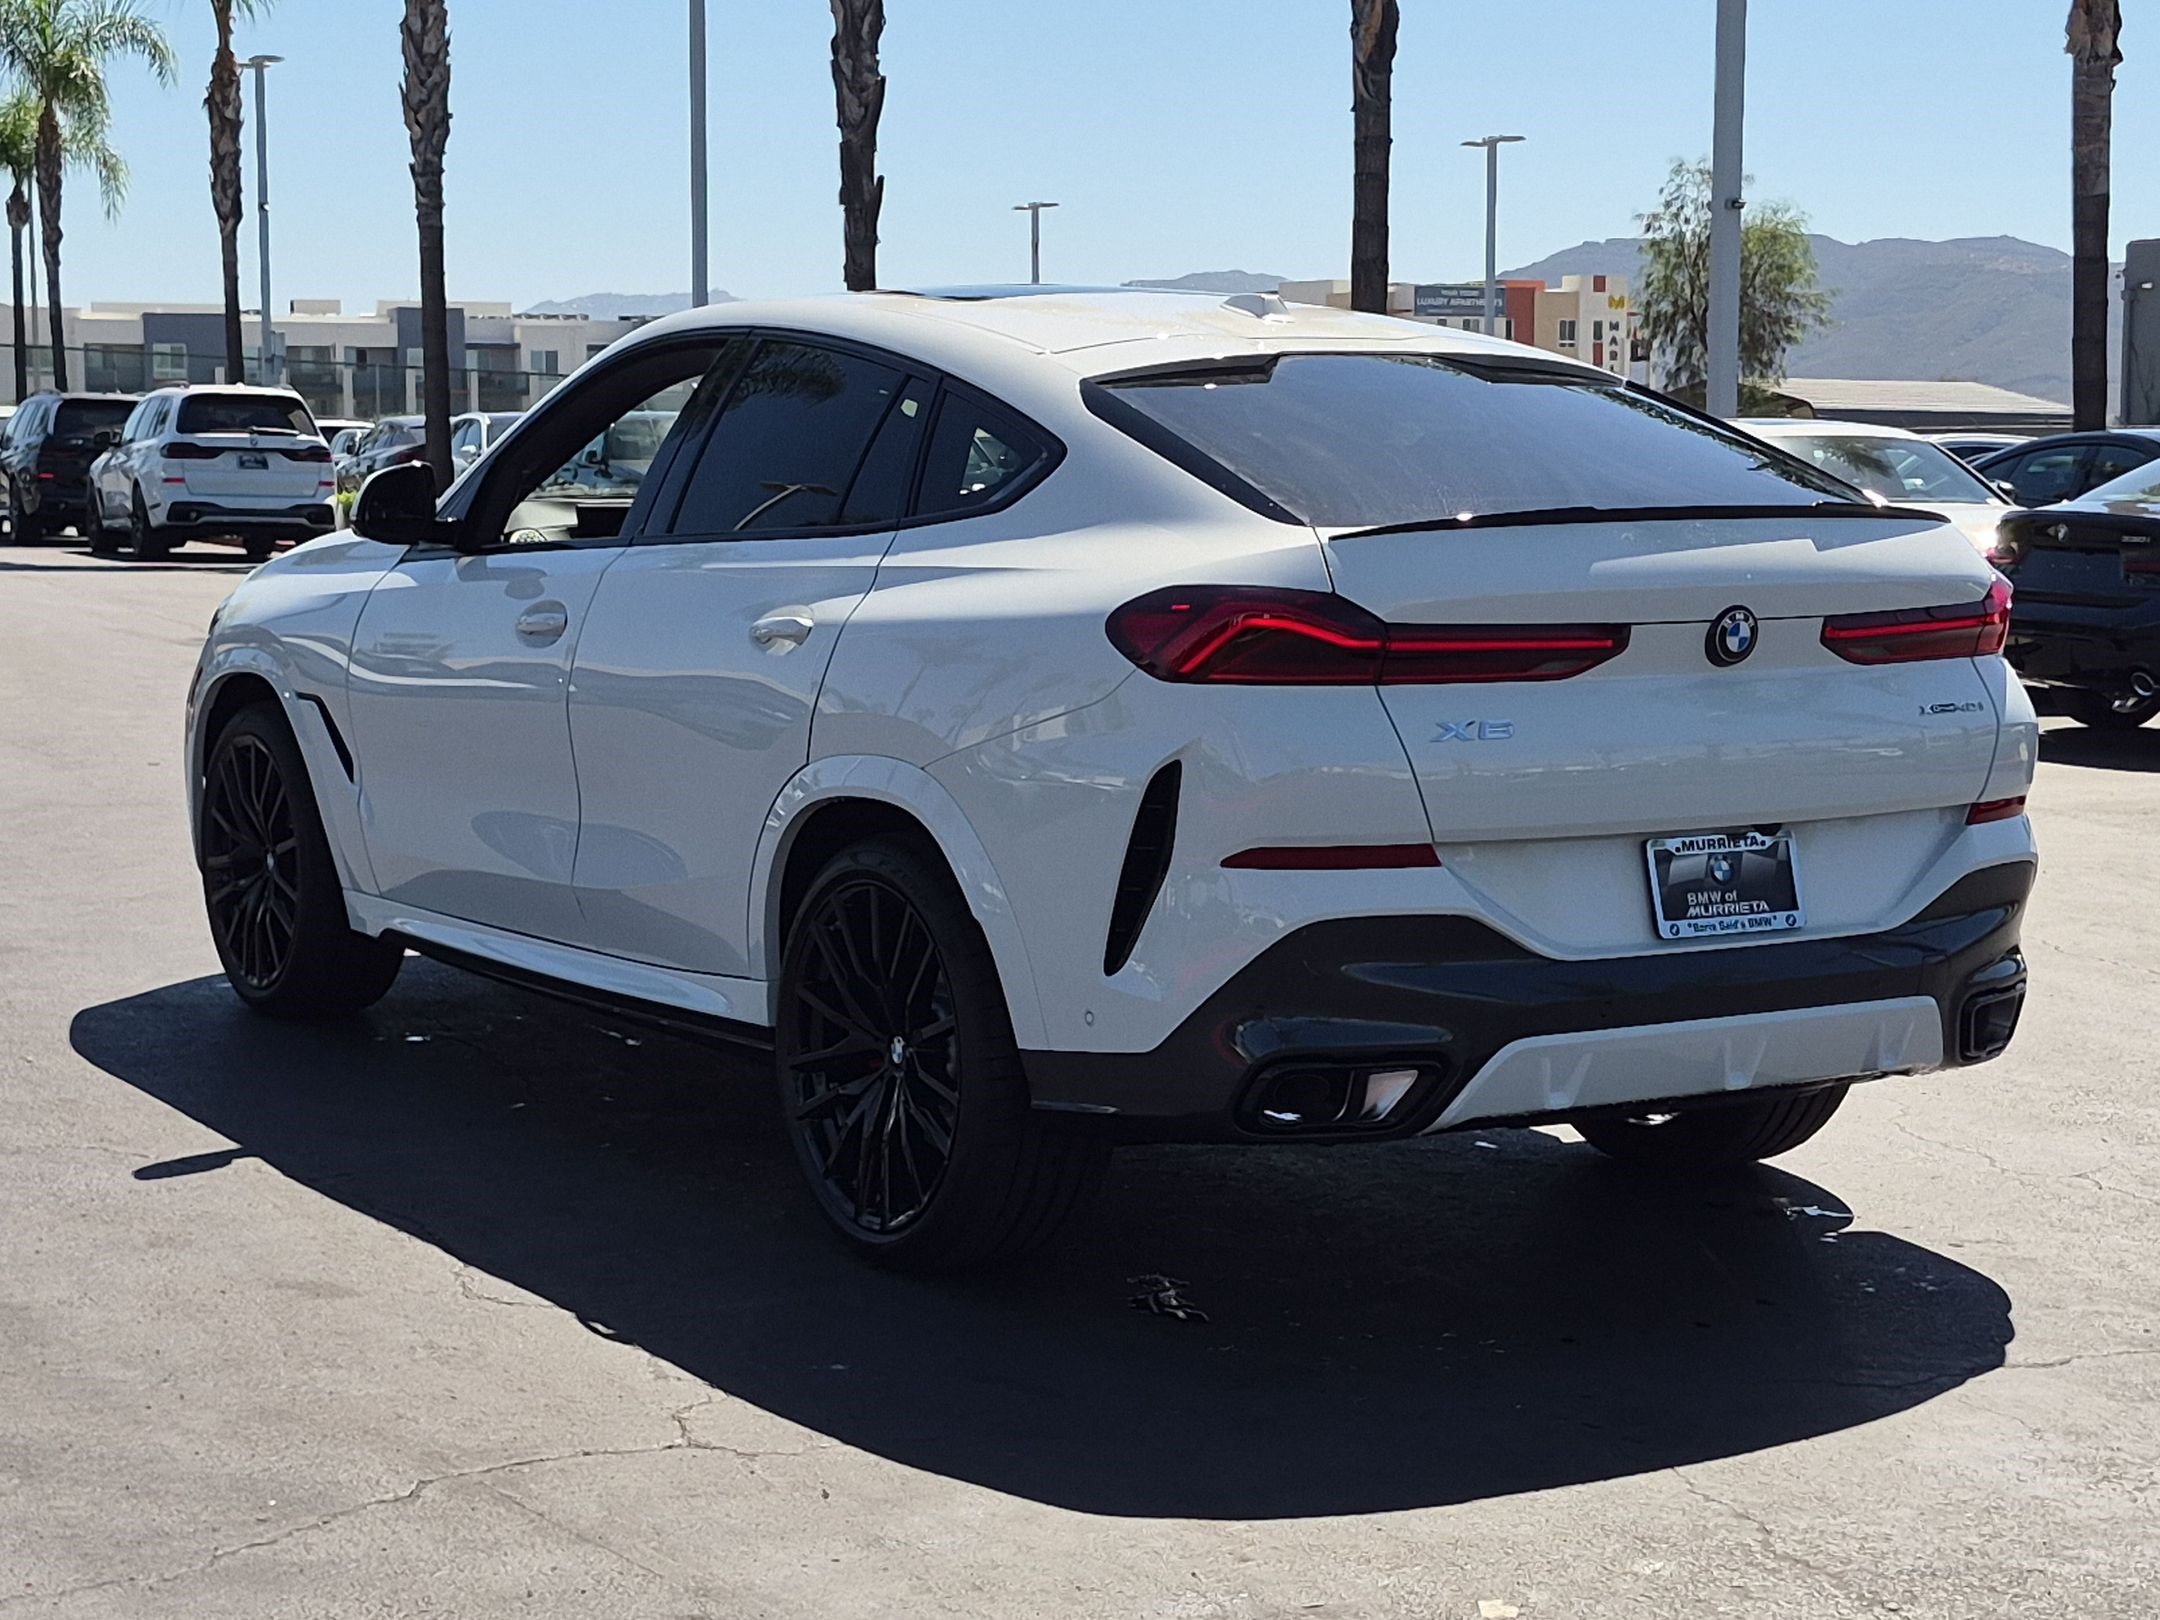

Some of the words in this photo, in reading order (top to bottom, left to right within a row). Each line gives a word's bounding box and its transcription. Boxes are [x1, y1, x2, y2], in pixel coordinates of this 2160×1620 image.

[1429, 719, 1514, 743] X6
[1681, 835, 1759, 852] MURRIETA
[1686, 890, 1722, 905] BMW
[1725, 889, 1738, 902] of
[1686, 900, 1770, 918] MURRIETA
